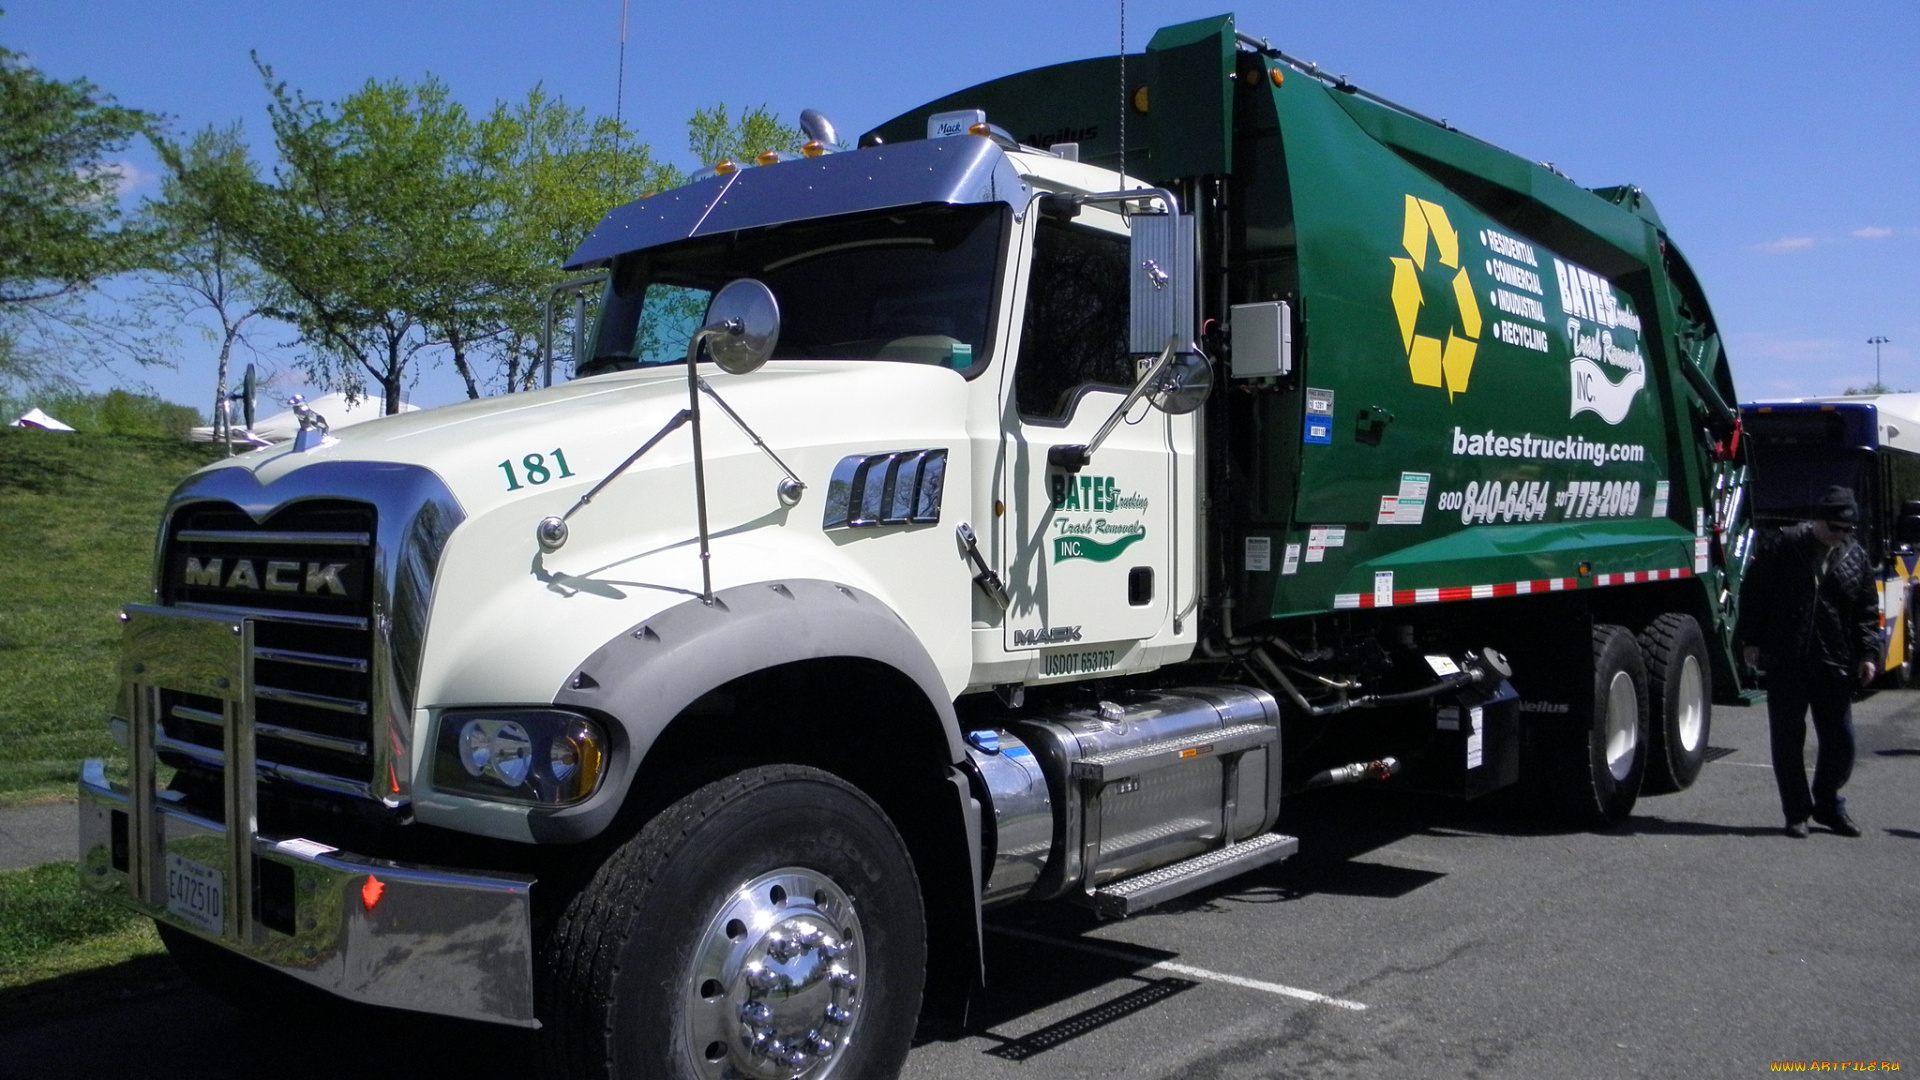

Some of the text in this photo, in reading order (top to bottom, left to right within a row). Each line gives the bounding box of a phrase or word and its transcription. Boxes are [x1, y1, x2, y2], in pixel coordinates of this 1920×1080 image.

[937, 121, 962, 136] Mack
[1018, 126, 1099, 149] Neilus
[1486, 228, 1539, 268] RESIDENTIAL
[1492, 258, 1544, 296] COMMERCIAL
[1553, 258, 1617, 329] BATES
[1501, 319, 1549, 353] RECYCLING
[1567, 317, 1602, 362] Trash
[1576, 370, 1597, 403] INC.
[1452, 426, 1645, 466] batestrucking.com
[498, 447, 576, 492] 181
[1052, 474, 1149, 515] BATES Trucking
[1438, 492, 1463, 510] 800
[1461, 481, 1550, 525] 840-6454
[1564, 481, 1641, 518] 773-2069
[1053, 517, 1141, 535] Trash Removal
[1061, 541, 1084, 556] INC.
[184, 556, 349, 596] MACK
[1014, 625, 1082, 647] MACK
[1045, 650, 1115, 676] USDOT 653767
